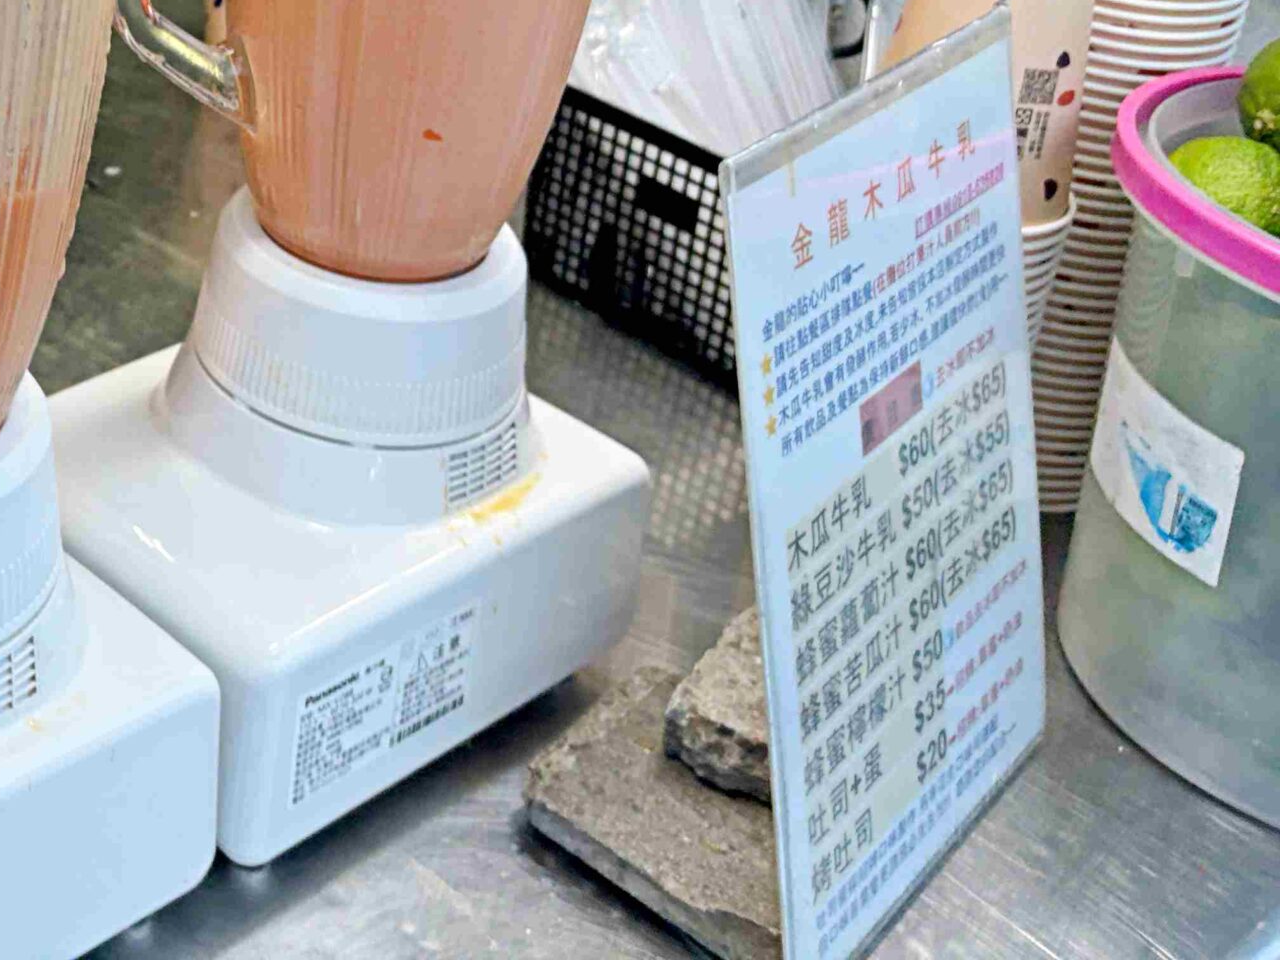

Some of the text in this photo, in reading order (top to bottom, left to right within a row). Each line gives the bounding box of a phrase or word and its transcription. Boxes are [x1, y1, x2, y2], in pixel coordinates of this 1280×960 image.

[790, 119, 976, 271] 金龍木瓜牛乳
[786, 474, 872, 573] 木瓜牛乳
[898, 360, 1006, 479] $60(去冰$65)
[790, 508, 897, 632] 綠豆沙牛乳
[901, 409, 1011, 531] $50(去冰$55)
[795, 458, 1014, 689] 蜂蜜蘿蔔汁 $60(去冰$65)
[799, 505, 1017, 744] 蜂蜜苦瓜汁 $60(去冰$65)
[304, 672, 360, 708] Panasonic
[803, 669, 907, 797] 蜂蜜檸檬汁
[911, 628, 944, 684] $50
[807, 741, 884, 847] 吐司+蛋
[913, 676, 947, 735] $35
[811, 806, 873, 907] 烤吐司
[916, 727, 949, 785] $20
